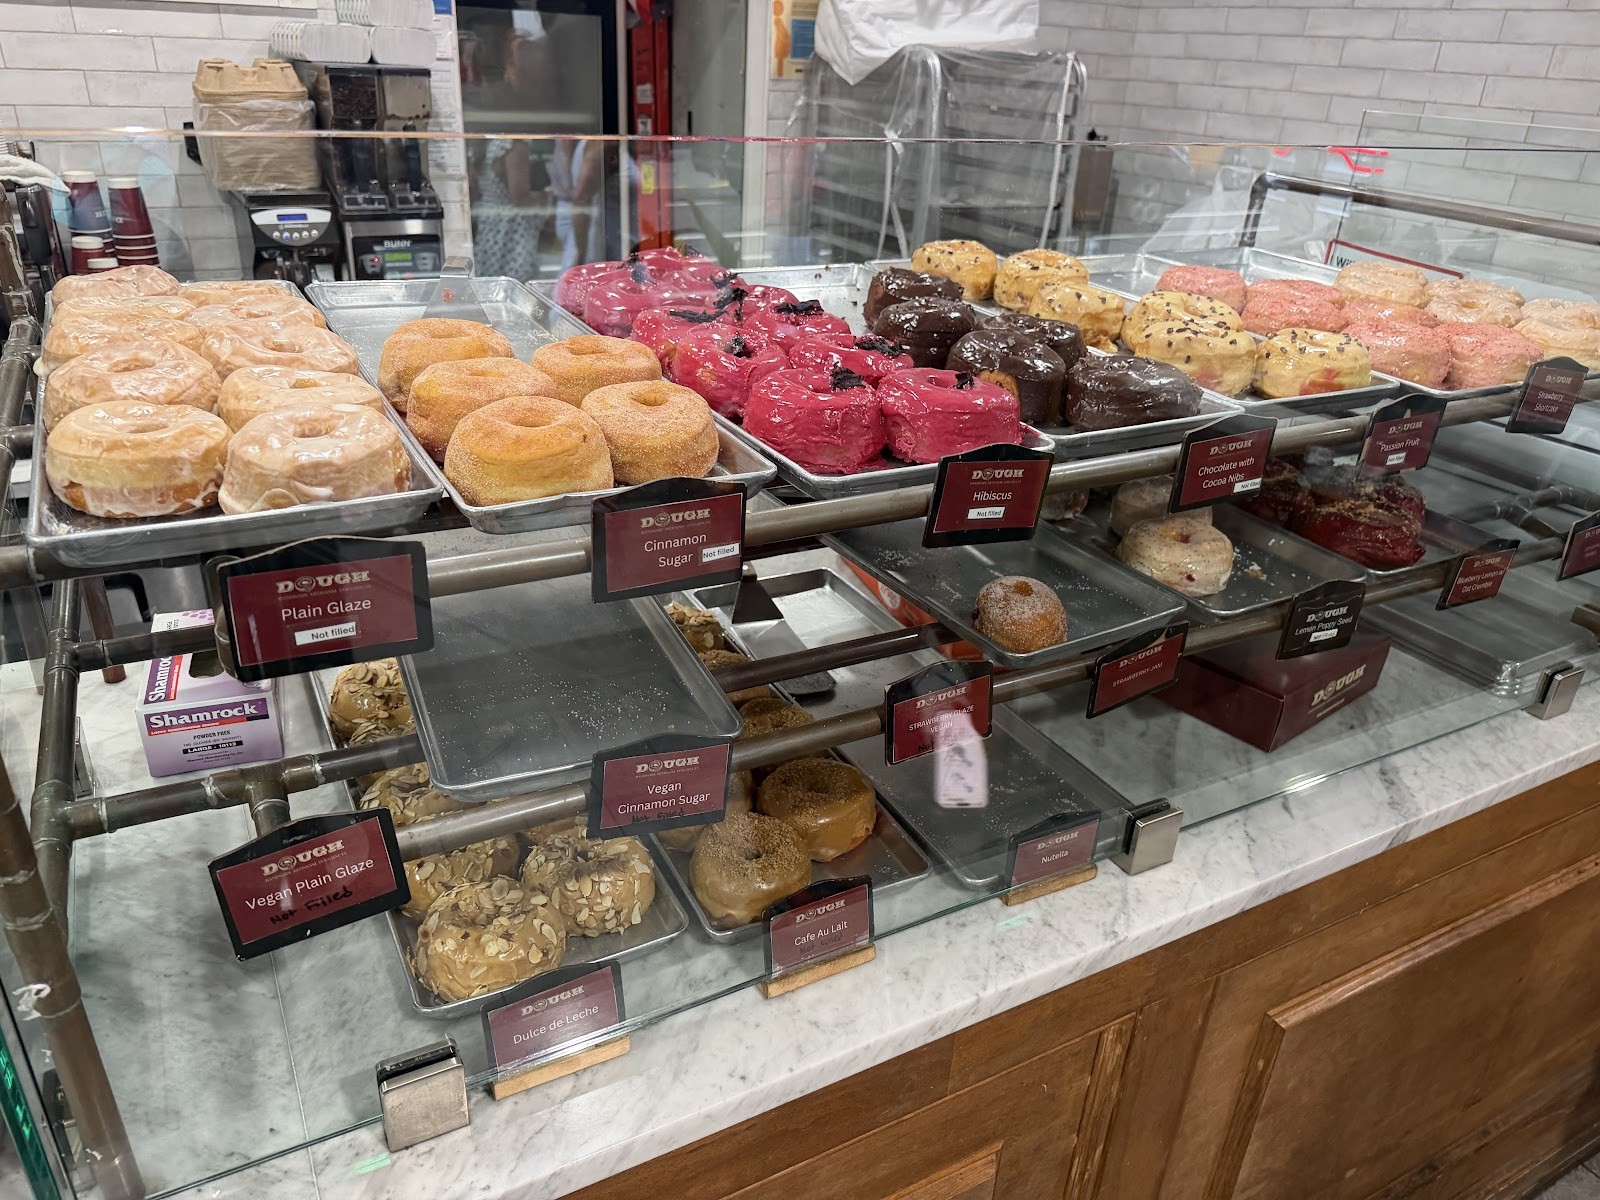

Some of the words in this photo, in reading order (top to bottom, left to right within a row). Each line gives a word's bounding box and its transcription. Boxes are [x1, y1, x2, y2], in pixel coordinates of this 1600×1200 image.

[384, 240, 411, 248] BUNN
[1538, 391, 1564, 402] Strawberry
[1534, 403, 1559, 412] Shortcake
[1209, 440, 1253, 455] DOUGH
[1380, 441, 1404, 452] Passion
[1405, 438, 1420, 447] Fruit
[972, 468, 1025, 480] DOUGH
[1198, 461, 1238, 476] Chocolate
[1239, 456, 1254, 468] with
[1202, 476, 1226, 488] Cocoa
[1227, 472, 1245, 483] Nibs
[973, 490, 1012, 501] Hibiscus
[641, 508, 710, 528] DOUGH
[644, 534, 707, 552] Cinnamon
[658, 553, 693, 567] Sugar
[717, 546, 735, 556] filled
[276, 571, 371, 593] DOUGH
[1457, 574, 1481, 584] Blueberry
[1481, 570, 1498, 579] Lemon
[1462, 585, 1472, 593] Oat
[1471, 581, 1493, 590] Crumble
[281, 605, 322, 621] Plain
[327, 599, 371, 614] Glaze
[1306, 606, 1349, 623] DOUGH
[311, 631, 329, 640] Not
[331, 625, 355, 637] filled
[1295, 625, 1317, 635] Lemon
[1317, 621, 1337, 630] Poppy
[1337, 615, 1353, 625] Seed
[1119, 645, 1163, 668] DOUGH
[148, 656, 172, 702] Shamroc
[1112, 667, 1150, 687] STRAWBERRY
[1150, 662, 1163, 672] JAM
[1311, 663, 1367, 706] DOUGH
[916, 686, 967, 709] DOUGH
[149, 702, 258, 729] Shamrock
[909, 711, 952, 731] STRAWBERRY
[953, 704, 975, 717] GLAZE
[193, 732, 216, 740] POWDER
[930, 720, 953, 733] VEGAN
[188, 745, 212, 753] LARGE
[636, 756, 700, 773] DOUGH
[647, 782, 682, 795] Vegan
[617, 798, 676, 814] Cinnamon
[679, 792, 710, 805] Sugar
[1036, 831, 1079, 851] DOUGH
[261, 840, 345, 876] DOUGH
[1041, 850, 1069, 864] Nutella
[245, 887, 293, 910] Vegan
[295, 874, 332, 894] Plain
[335, 858, 374, 880] Glaze
[270, 909, 297, 924] Not
[795, 899, 846, 923] DOUGH
[794, 932, 816, 946] Cafe
[817, 928, 829, 938] Au
[831, 920, 848, 933] Lait
[521, 985, 585, 1016] DOUGH
[513, 1026, 546, 1044] Dulce
[549, 1020, 563, 1031] de
[566, 1005, 599, 1024] Leche
